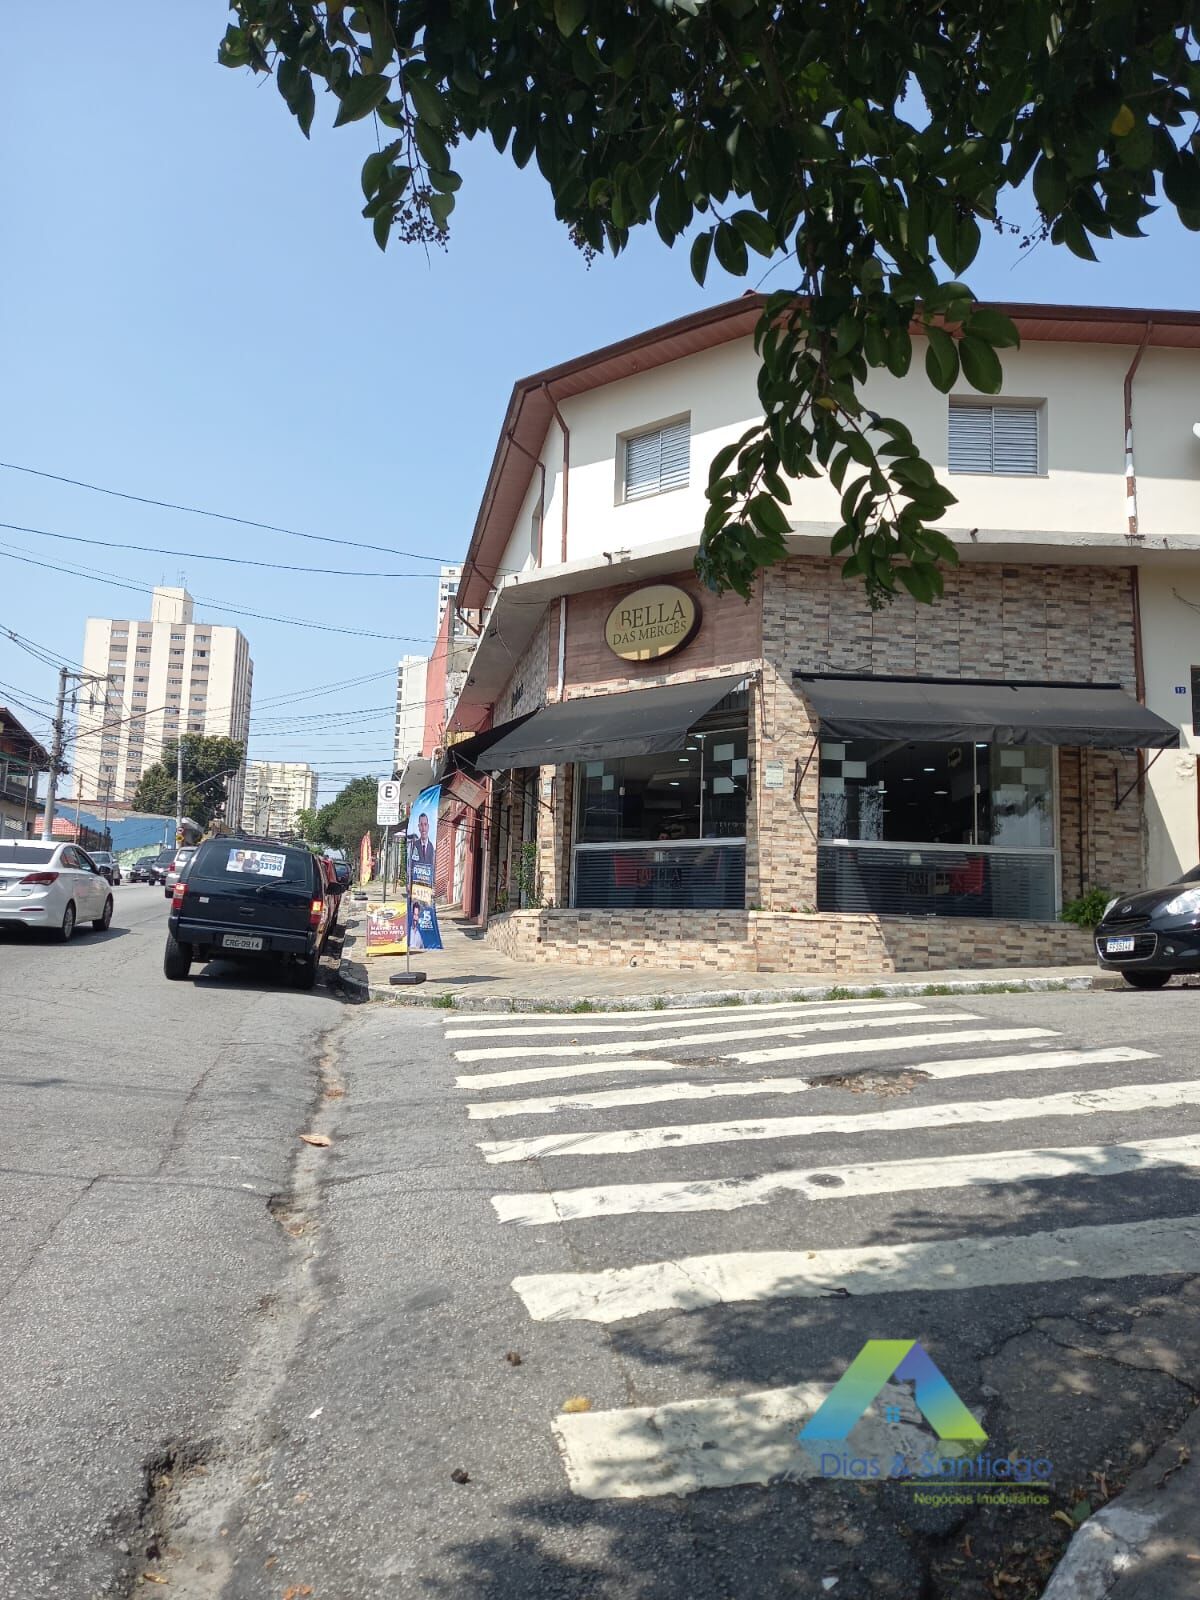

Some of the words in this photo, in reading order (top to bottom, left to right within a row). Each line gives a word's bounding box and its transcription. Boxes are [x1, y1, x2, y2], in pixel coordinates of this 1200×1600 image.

[619, 599, 686, 629] BELLA
[612, 631, 636, 646] DAS
[638, 620, 687, 640] MERCÊS
[385, 786, 393, 798] E
